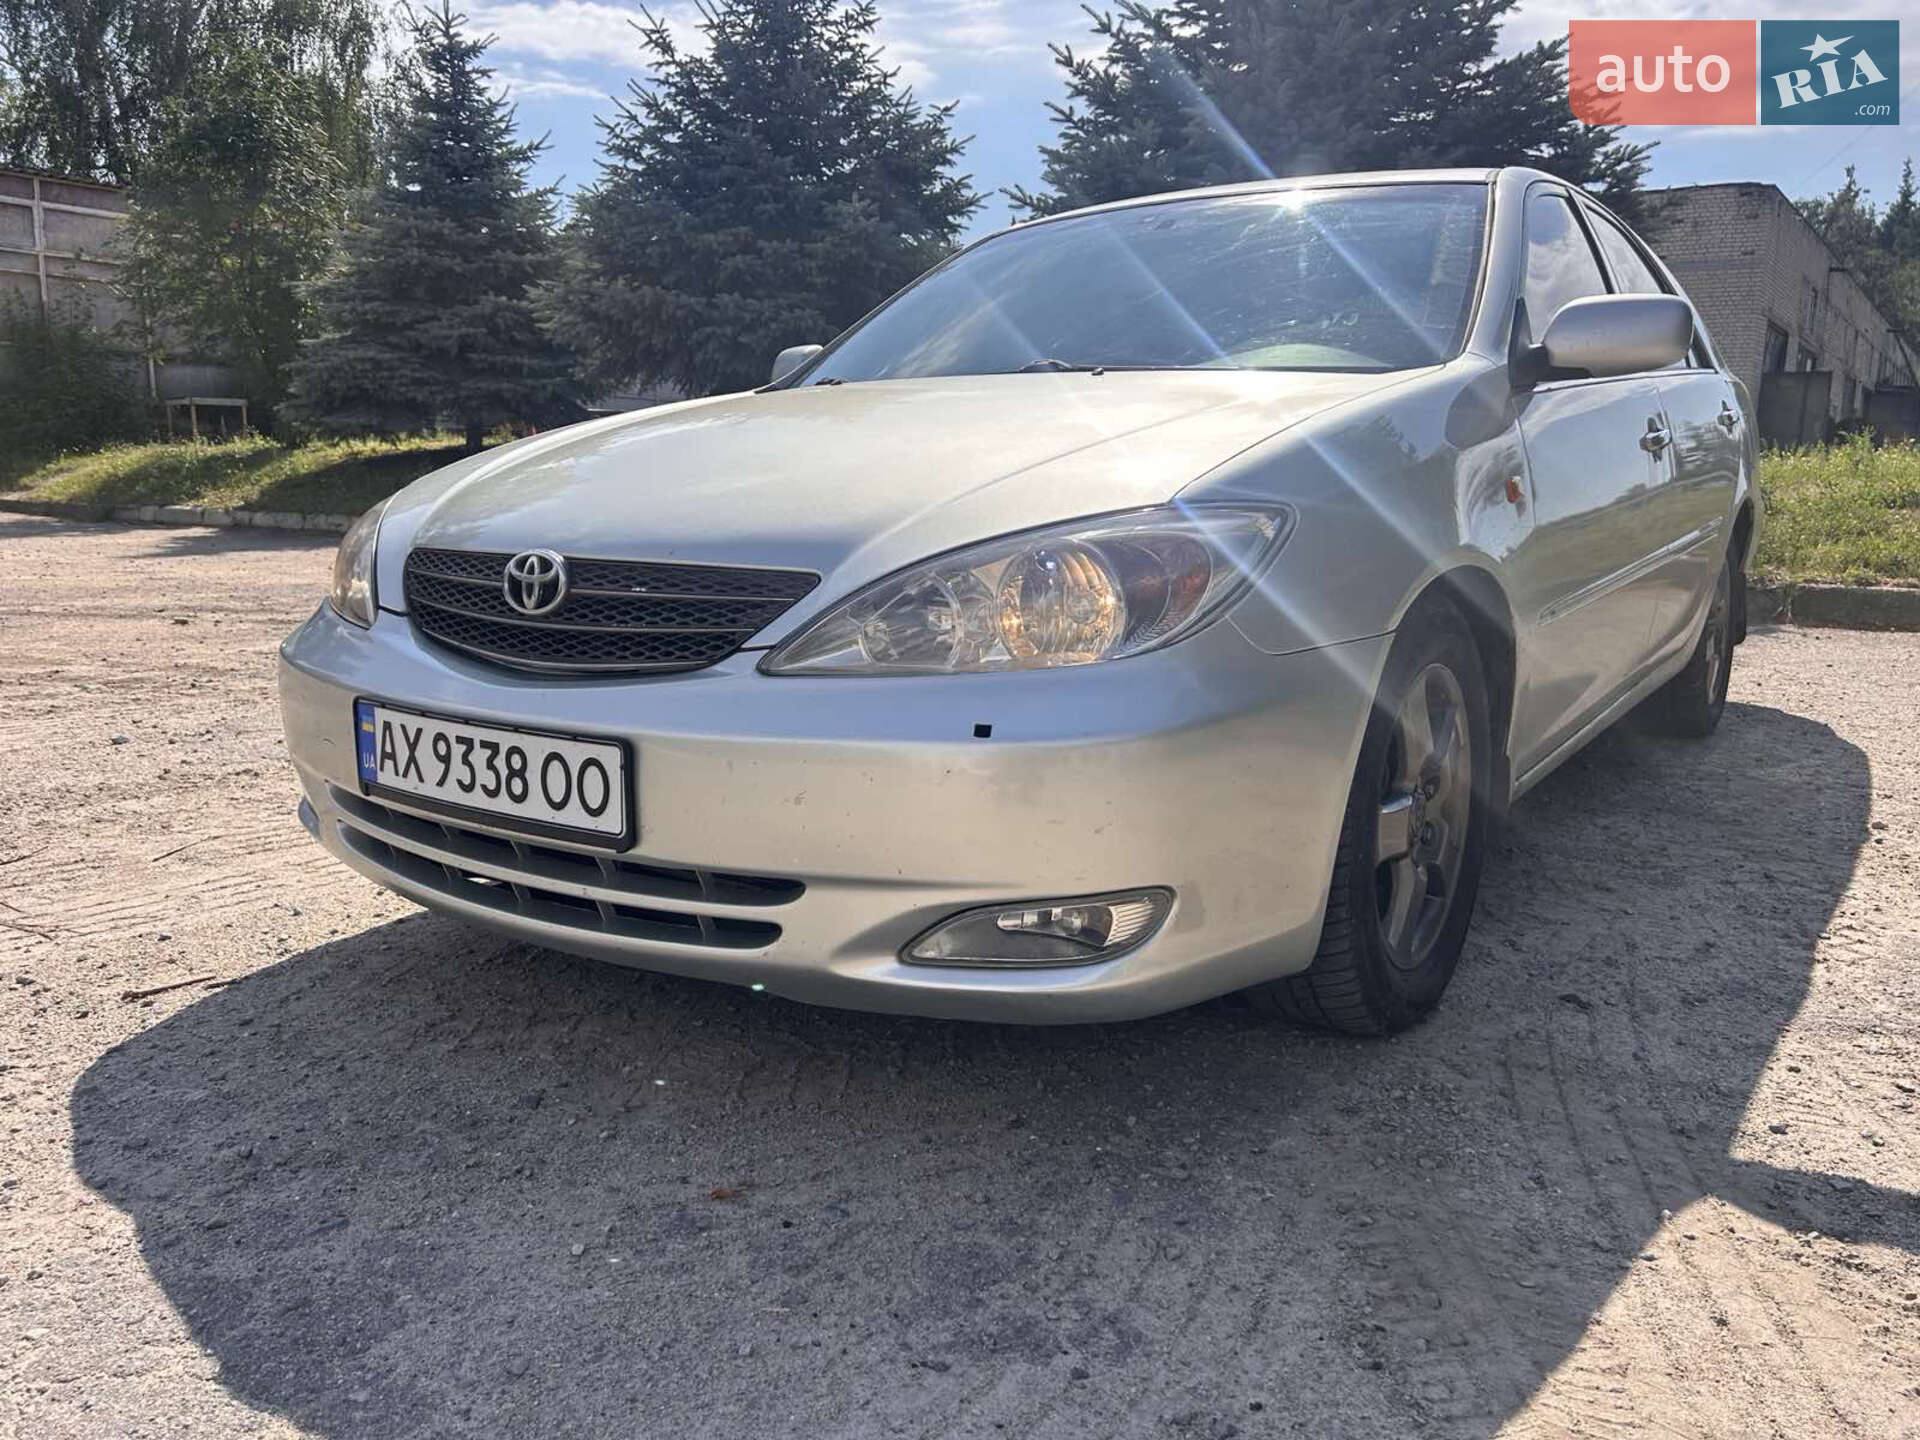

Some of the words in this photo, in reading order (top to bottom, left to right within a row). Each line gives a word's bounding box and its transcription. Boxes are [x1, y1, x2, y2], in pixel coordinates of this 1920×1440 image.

[363, 755, 377, 770] UA
[380, 720, 424, 783] AX
[432, 732, 528, 804] 9338
[541, 751, 610, 817] OO
